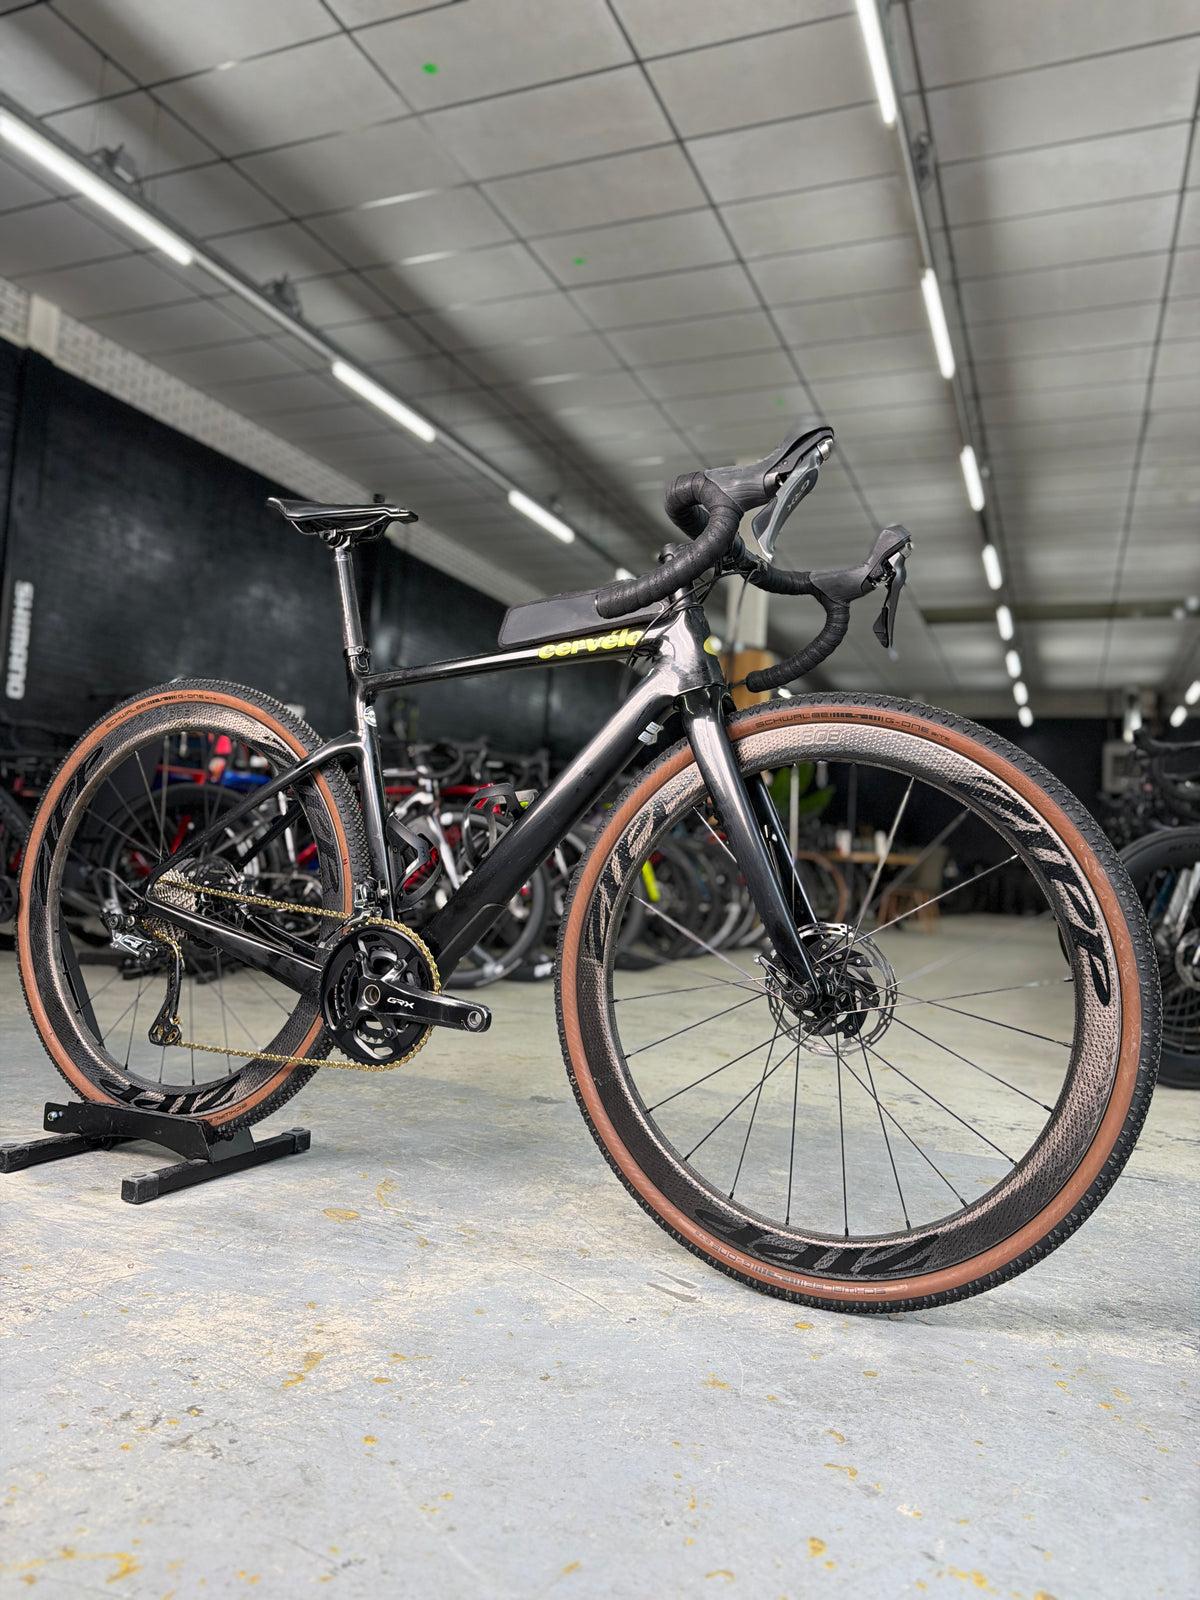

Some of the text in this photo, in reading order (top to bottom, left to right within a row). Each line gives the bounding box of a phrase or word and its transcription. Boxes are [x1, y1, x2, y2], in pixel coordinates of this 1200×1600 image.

[537, 628, 645, 659] cervélo
[105, 702, 147, 728] SCHWALBE
[755, 711, 831, 728] SCHWALBE
[885, 717, 929, 734] G-ONE
[951, 776, 1111, 1006] ZIPP
[387, 996, 415, 1010] GRX
[100, 1074, 241, 1114] ZIPP
[695, 1208, 940, 1275] ZIPP
[806, 1280, 886, 1295] SCHWALBE
